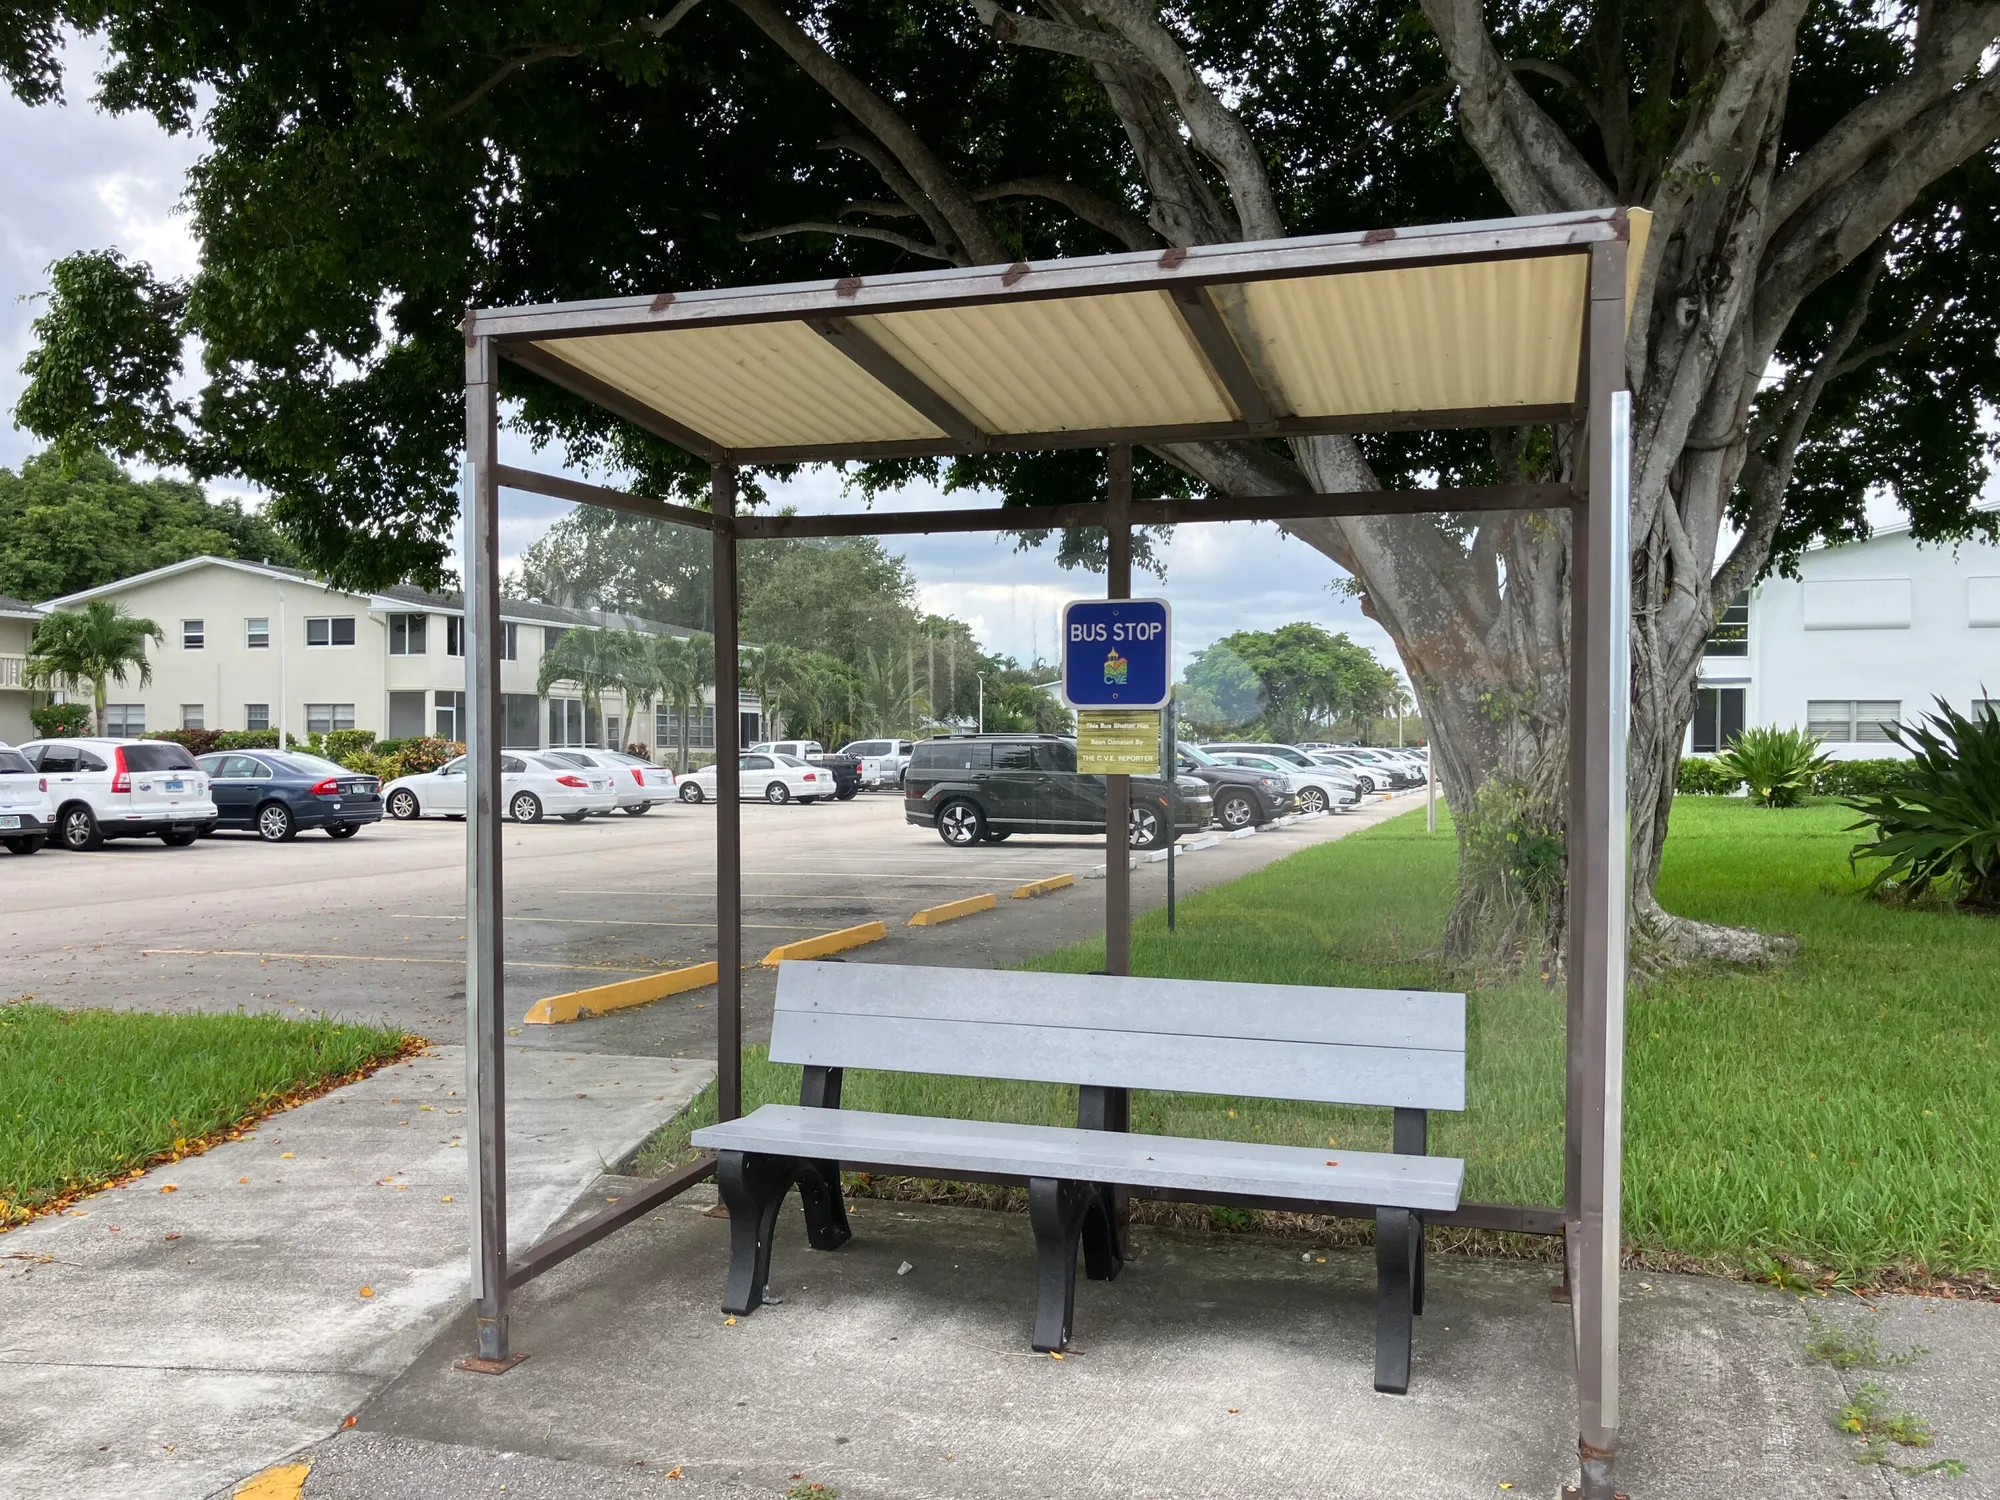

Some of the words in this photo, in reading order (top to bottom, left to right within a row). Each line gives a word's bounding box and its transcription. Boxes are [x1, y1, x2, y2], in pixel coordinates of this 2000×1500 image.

[1070, 623, 1107, 642] BUS
[1113, 622, 1162, 642] STOP
[1103, 674, 1128, 685] CVE
